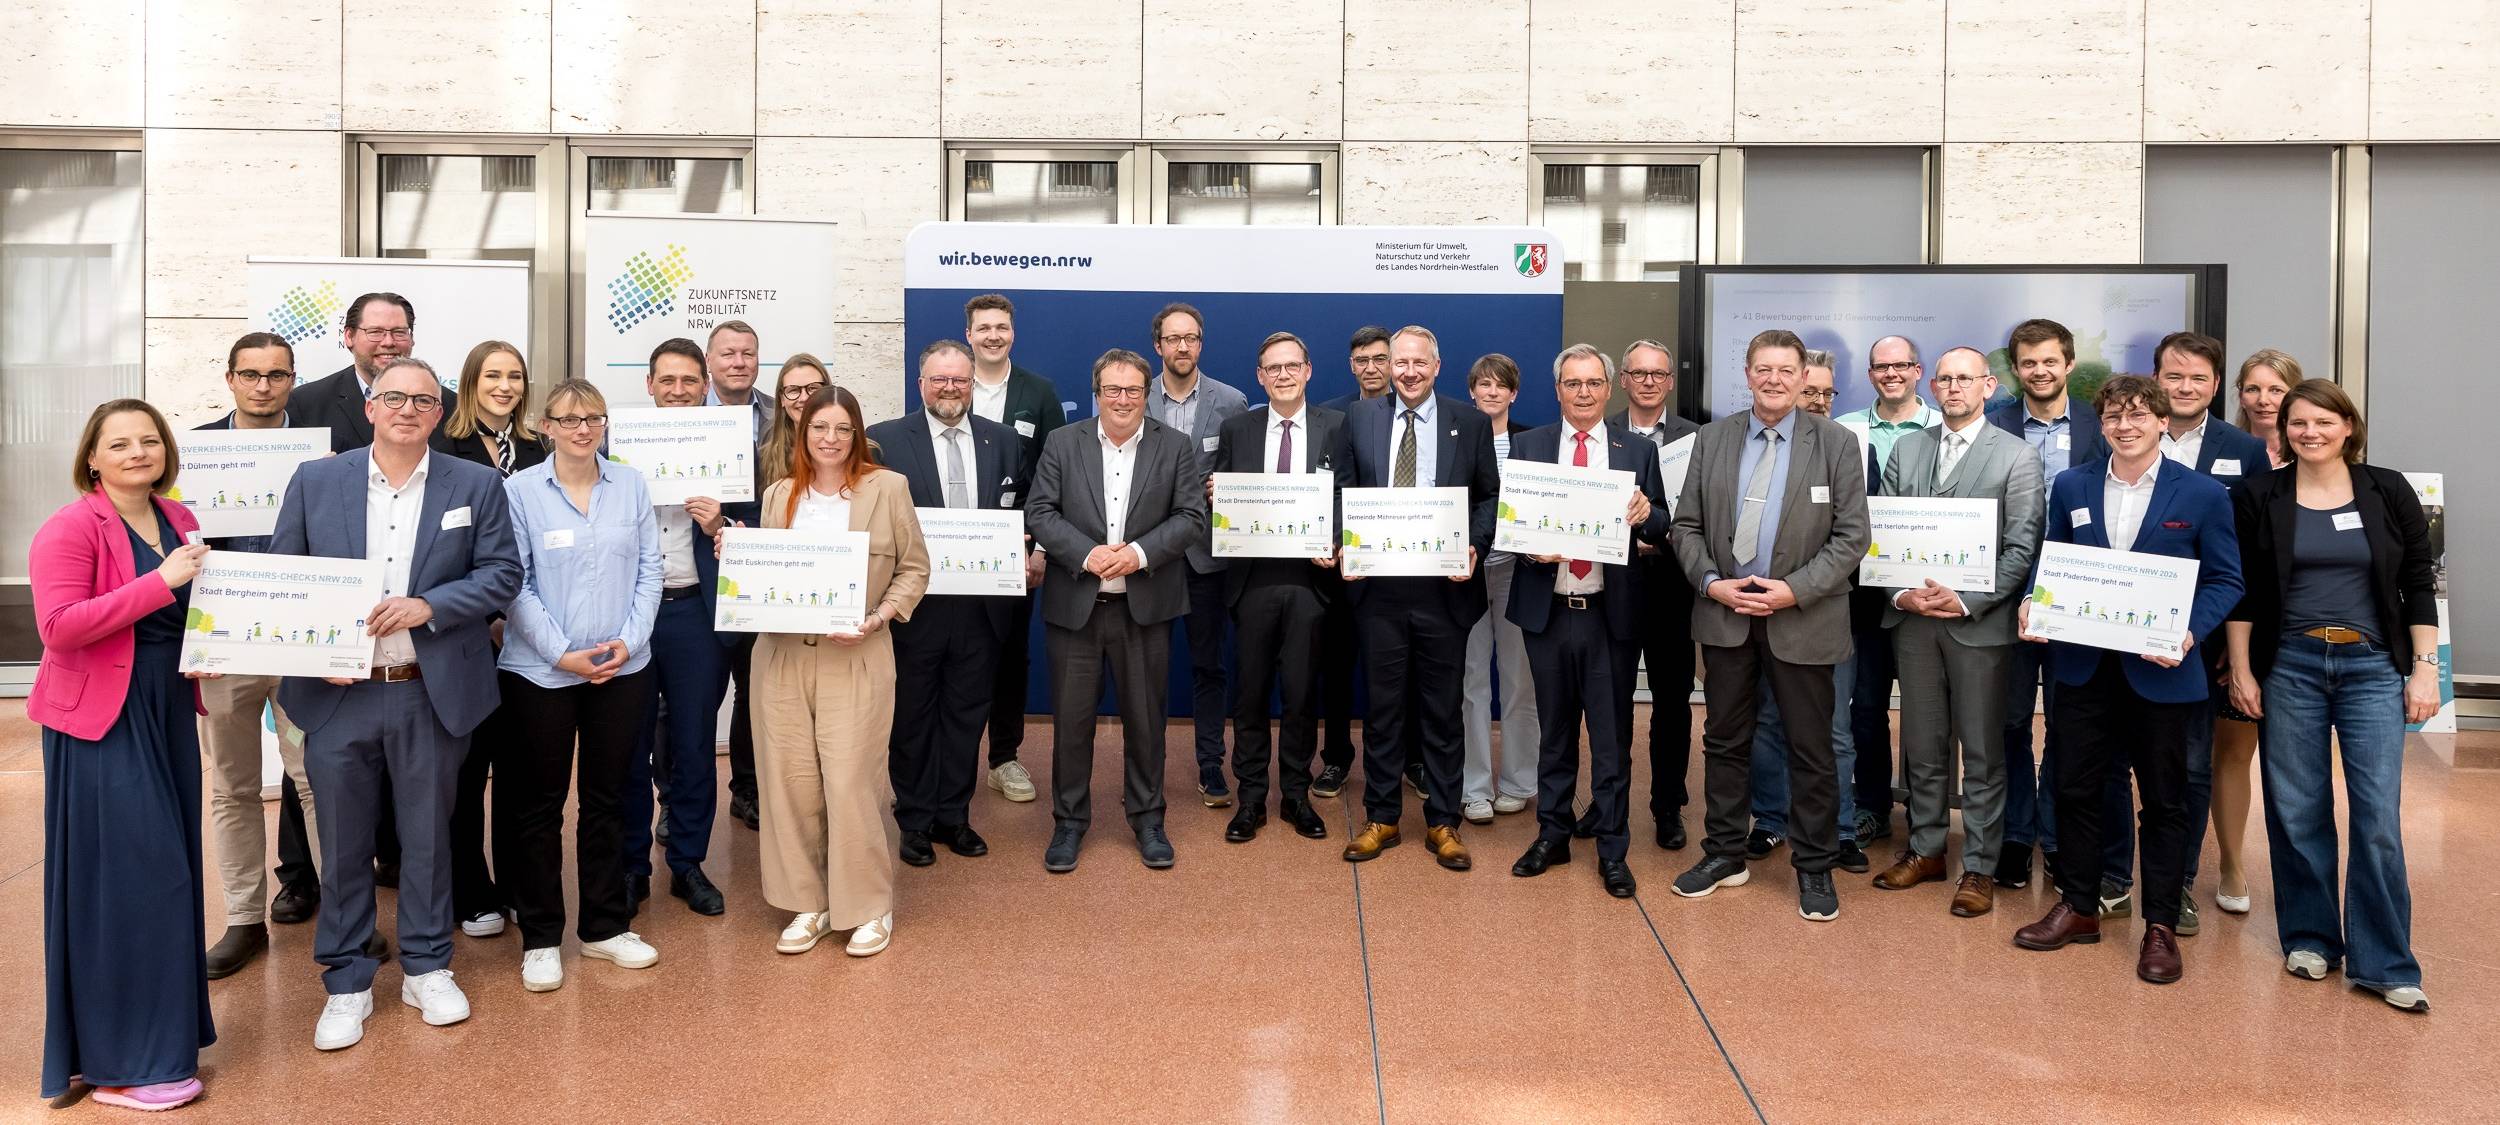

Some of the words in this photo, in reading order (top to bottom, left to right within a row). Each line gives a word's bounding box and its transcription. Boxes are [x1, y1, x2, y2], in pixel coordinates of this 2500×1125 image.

[1423, 242, 1434, 250] für
[1436, 242, 1468, 251] Umwelt,
[939, 251, 1092, 269] wir.bewegen.nrw
[688, 289, 777, 301] ZUKUNFTSNETZ
[688, 302, 747, 315] MOBILITÄT
[1742, 312, 1752, 320] 41
[1754, 312, 1812, 322] Bewerbungen
[1814, 313, 1830, 321] und
[688, 319, 714, 329] NRW
[178, 444, 269, 454] SVERKEHRS-CHECKS
[221, 462, 238, 470] geht
[2046, 555, 2138, 573] FUSSVERKEHRS-CHECKS
[2139, 568, 2159, 576] NRW
[202, 568, 317, 582] FUSSVERKEHRS-CHECKS
[2043, 569, 2062, 578] Stadt
[2063, 573, 2100, 583] Paderborn
[2101, 578, 2117, 586] geht
[2119, 580, 2133, 588] mit!
[199, 587, 223, 595] Stadt
[225, 588, 267, 599] Bergheim
[270, 592, 289, 600] geht
